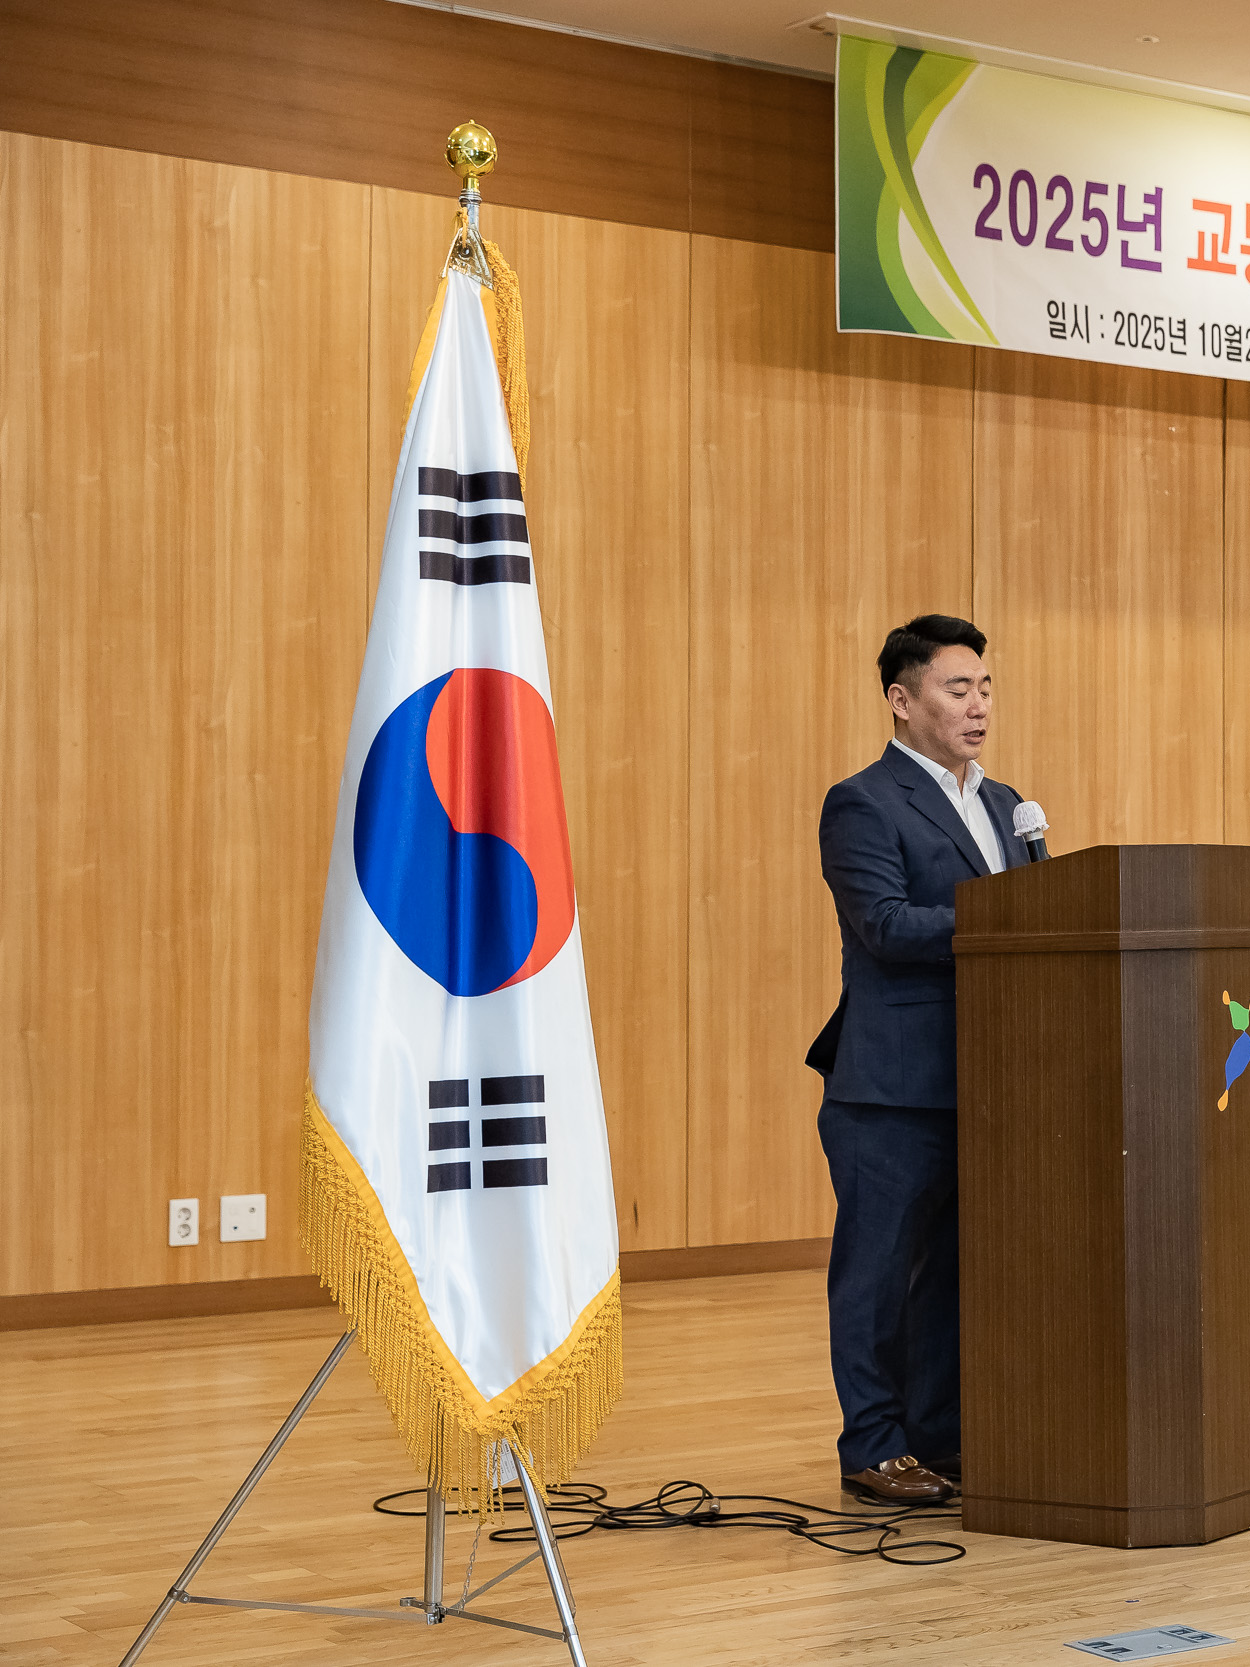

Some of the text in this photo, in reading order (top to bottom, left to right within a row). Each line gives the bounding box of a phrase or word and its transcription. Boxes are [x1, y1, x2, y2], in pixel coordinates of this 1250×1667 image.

[973, 163, 1163, 272] 2025년
[1046, 300, 1090, 343] 일시
[1113, 310, 1187, 357] 2025년
